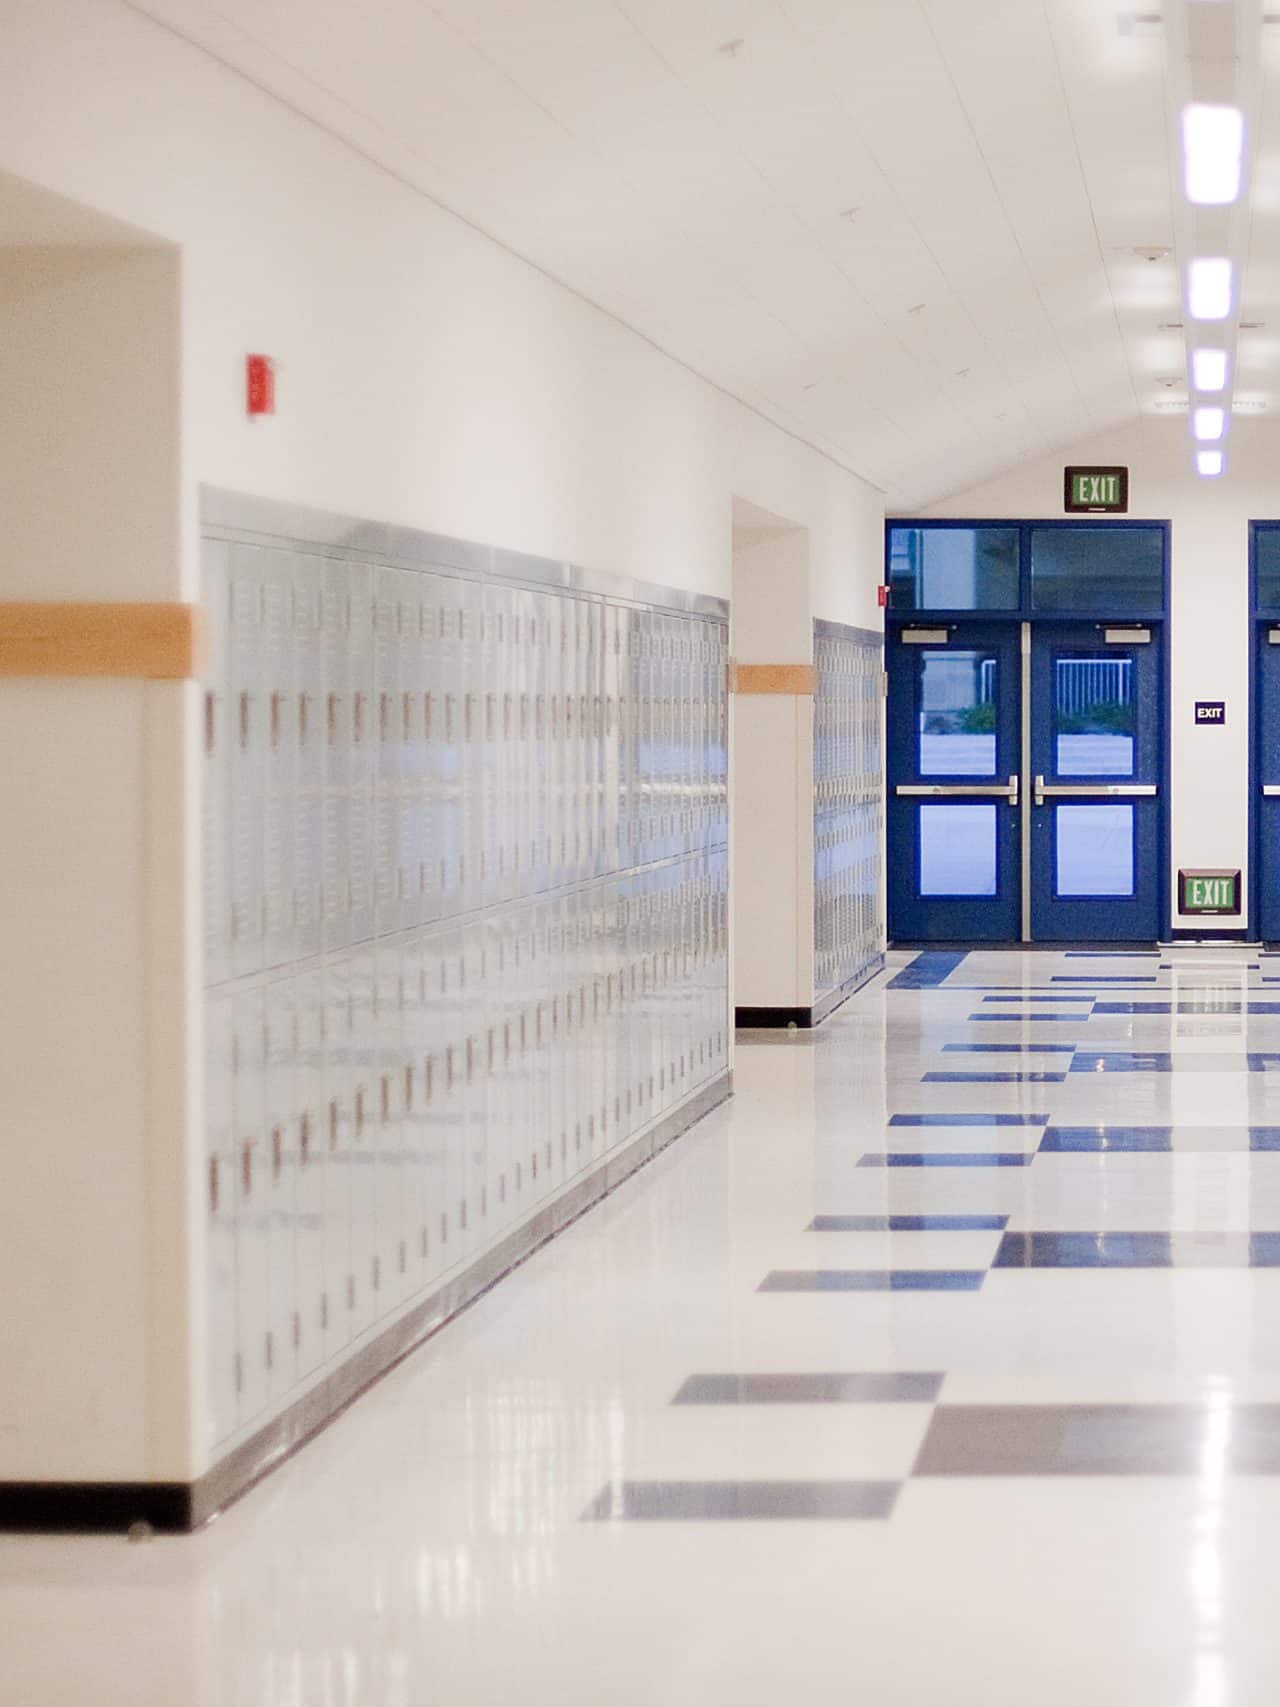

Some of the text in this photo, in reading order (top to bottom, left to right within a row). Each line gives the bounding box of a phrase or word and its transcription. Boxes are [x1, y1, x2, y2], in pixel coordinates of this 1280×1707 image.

[1079, 477, 1116, 502] EXIT
[1197, 708, 1223, 718] EXIT
[1192, 880, 1230, 905] EXIT
